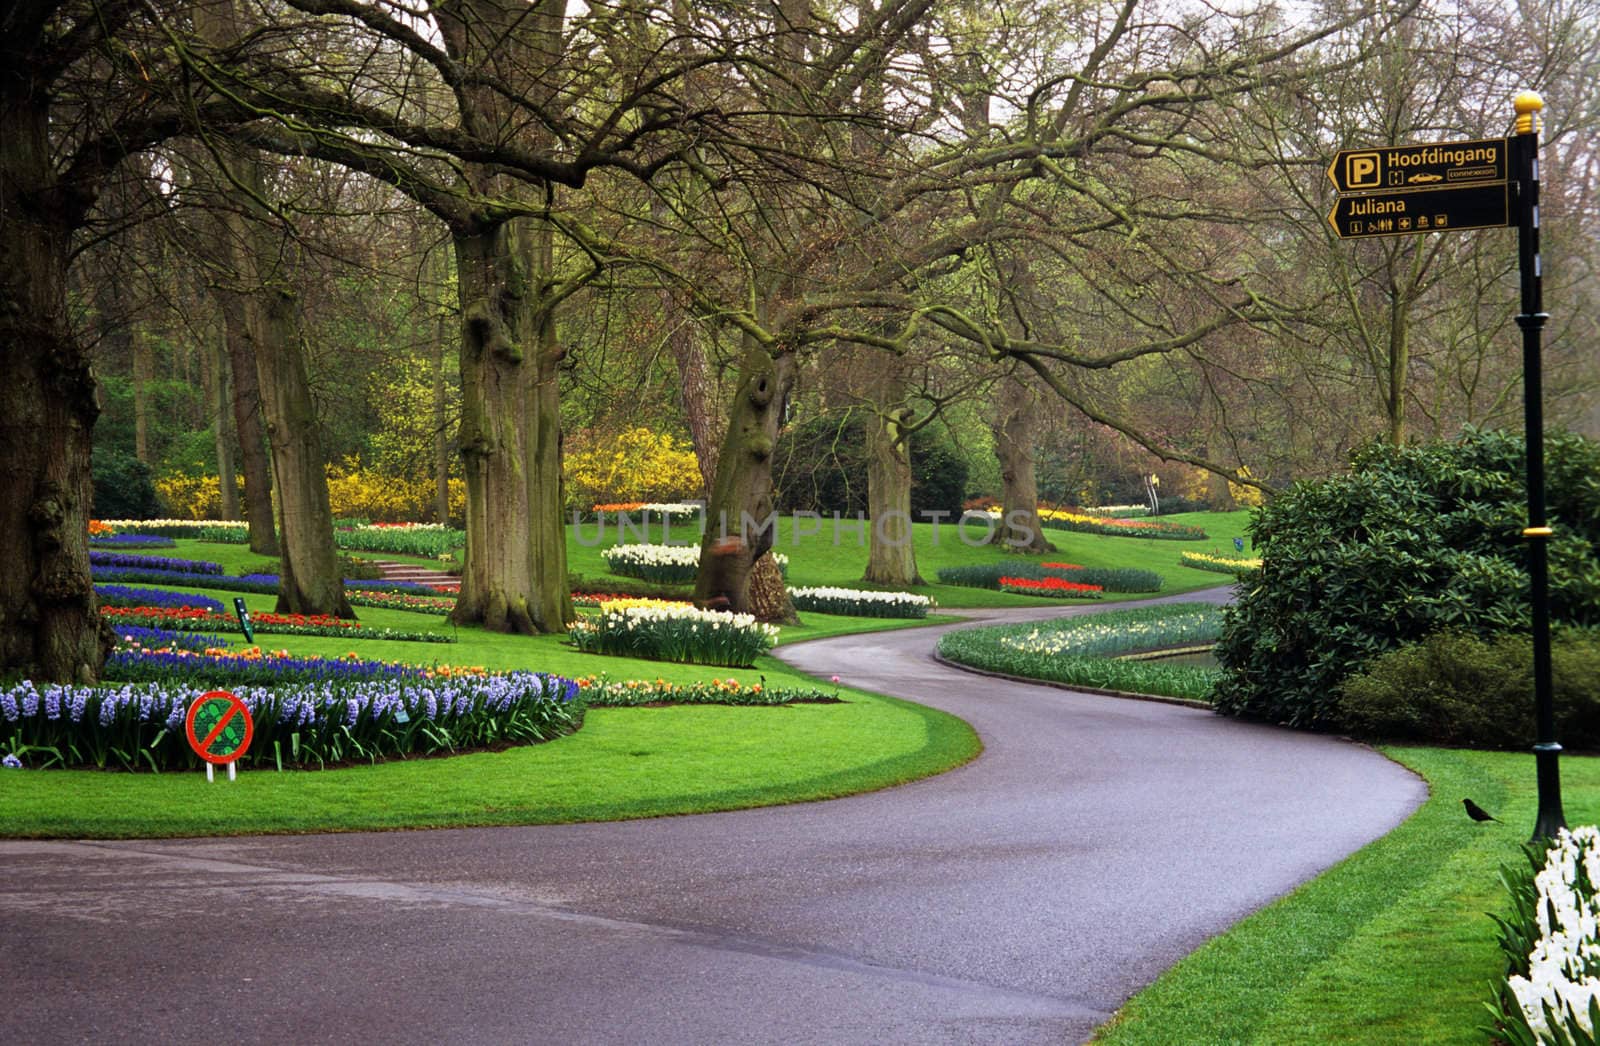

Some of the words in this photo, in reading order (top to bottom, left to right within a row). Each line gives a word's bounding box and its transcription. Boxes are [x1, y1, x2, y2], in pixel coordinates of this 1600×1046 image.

[1352, 158, 1375, 184] P
[1388, 147, 1497, 167] Hoofdingang
[1348, 199, 1406, 216] Juliana
